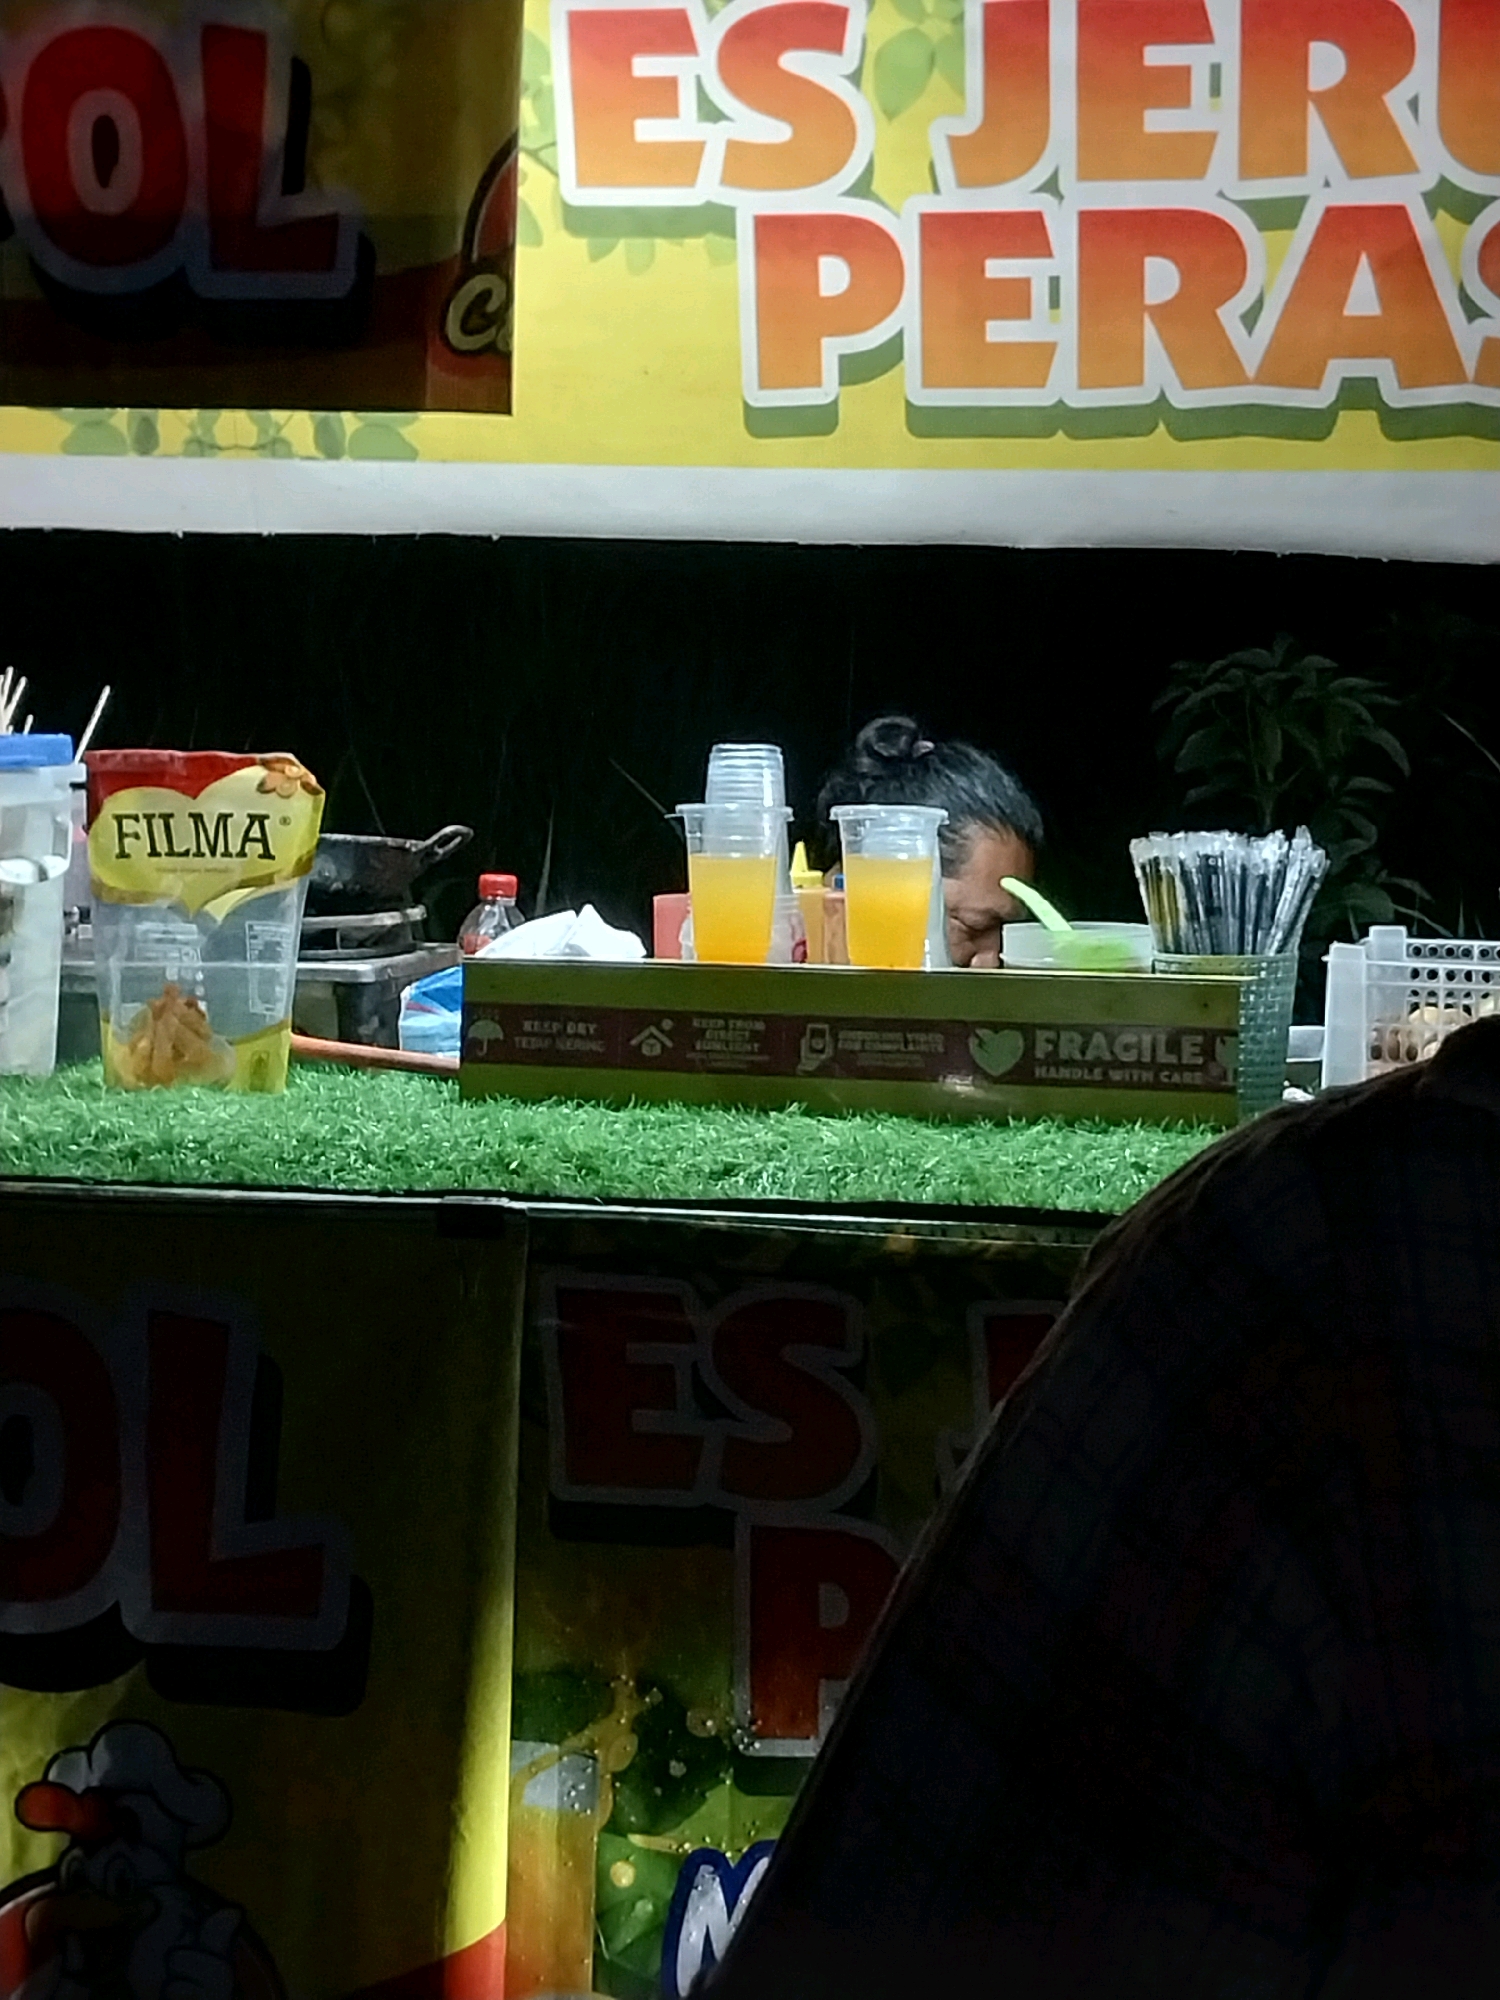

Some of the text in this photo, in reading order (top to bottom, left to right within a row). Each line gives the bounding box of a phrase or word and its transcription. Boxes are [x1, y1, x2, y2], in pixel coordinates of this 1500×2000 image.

[0, 18, 352, 282] OL
[562, 2, 860, 192] ES
[748, 202, 1500, 392] PERA
[111, 812, 276, 861] FILMA
[566, 1021, 597, 1036] DRY
[1034, 1029, 1204, 1065] FRAGILE
[1034, 1065, 1204, 1085] HANDLE WITH CARE
[553, 1283, 866, 1504] ES
